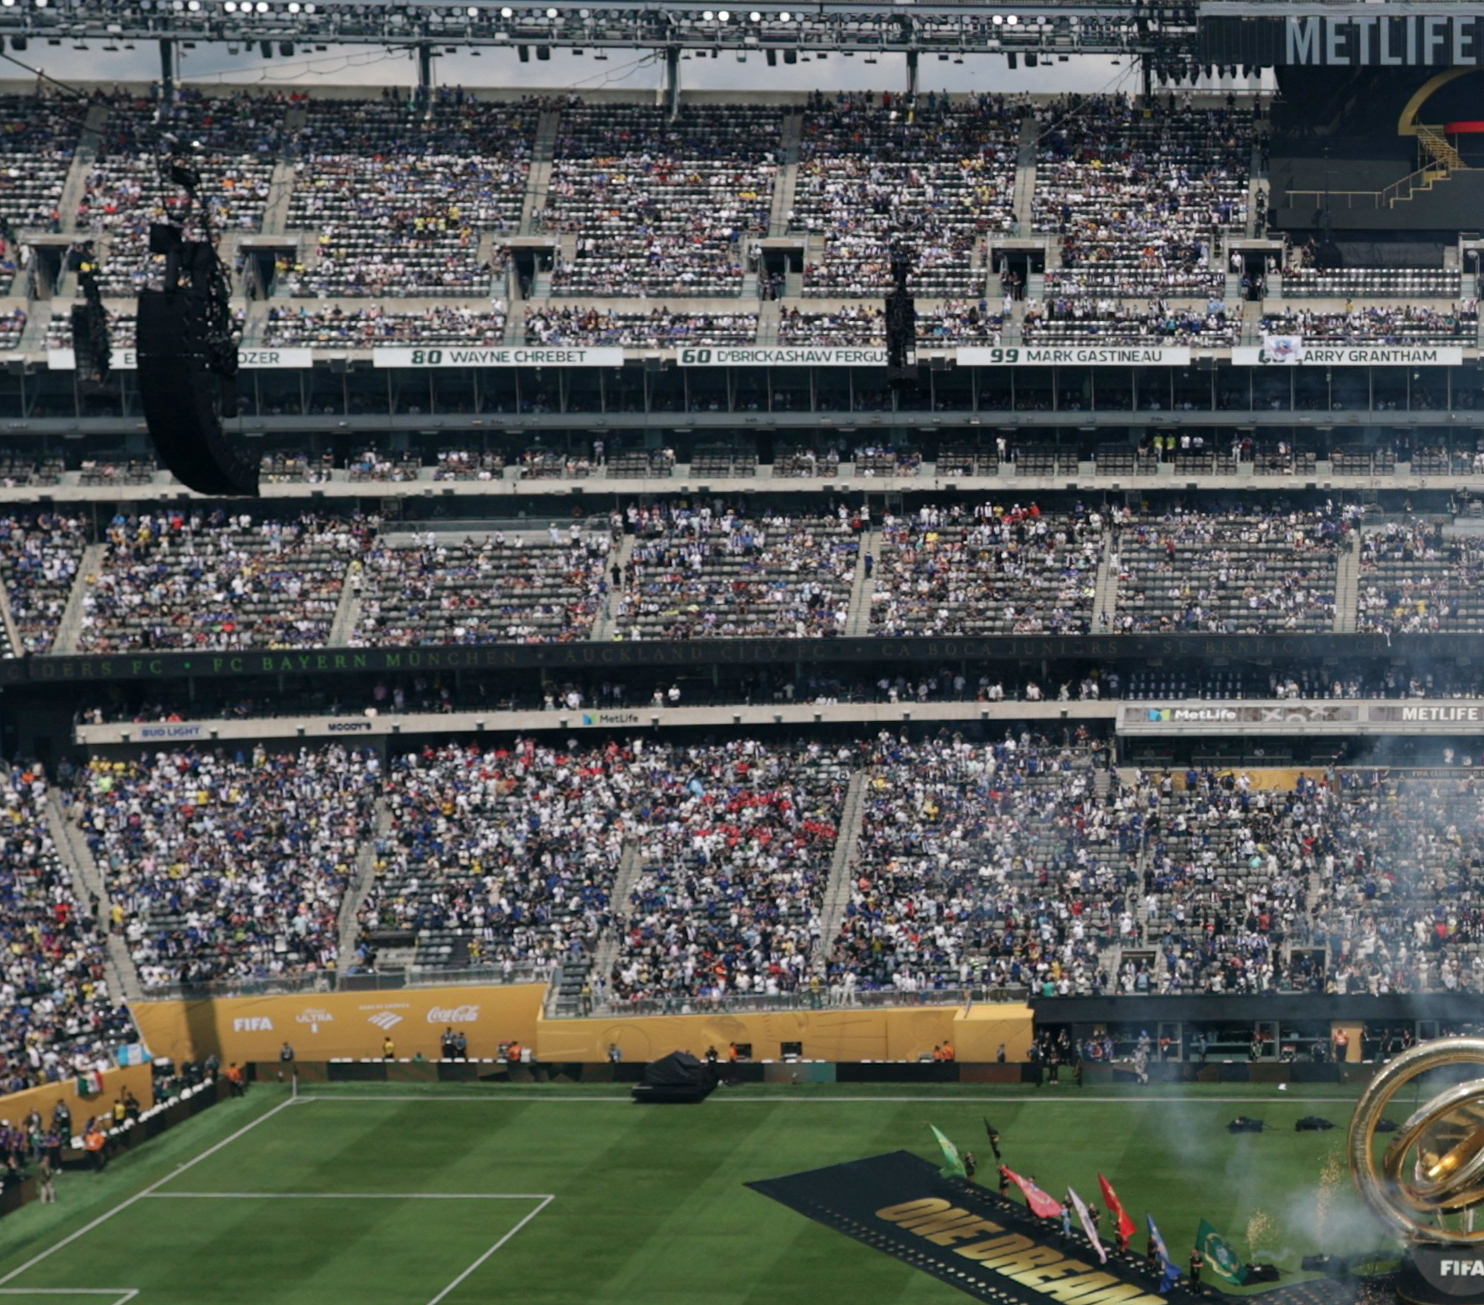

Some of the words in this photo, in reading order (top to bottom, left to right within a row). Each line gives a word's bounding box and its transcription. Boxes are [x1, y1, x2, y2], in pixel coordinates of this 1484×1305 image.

[1286, 16, 1477, 65] METLIFE
[237, 352, 279, 364] OZER
[412, 351, 442, 363] 80
[450, 352, 510, 362] WAYNE
[515, 352, 586, 362] CHREBET
[682, 350, 711, 363] 60
[991, 350, 1019, 363] 99
[1027, 351, 1072, 362] MARK
[1078, 351, 1163, 362] GASTINEAU
[1296, 351, 1343, 363] ARRY
[1348, 351, 1437, 362] GRANTHAM
[564, 647, 704, 663] AUCKLAND
[719, 645, 779, 660] CITY
[797, 644, 826, 658] FC
[928, 641, 993, 656] BOCA
[212, 657, 242, 672] FC
[262, 652, 367, 672] BAYERN
[385, 649, 517, 669] MÜNCHEN
[132, 660, 162, 675] FC
[600, 713, 638, 724] MetLife
[1174, 709, 1236, 721] MetLife
[1402, 707, 1478, 721] METLIFE
[142, 728, 166, 738] BUD
[167, 726, 201, 737] LIGHT
[328, 722, 372, 732] MOODY'S
[296, 1013, 334, 1023] ULTRA
[426, 1005, 481, 1024] Coca-Cola
[233, 1017, 273, 1032] FIFA
[876, 1197, 1006, 1247] ONE
